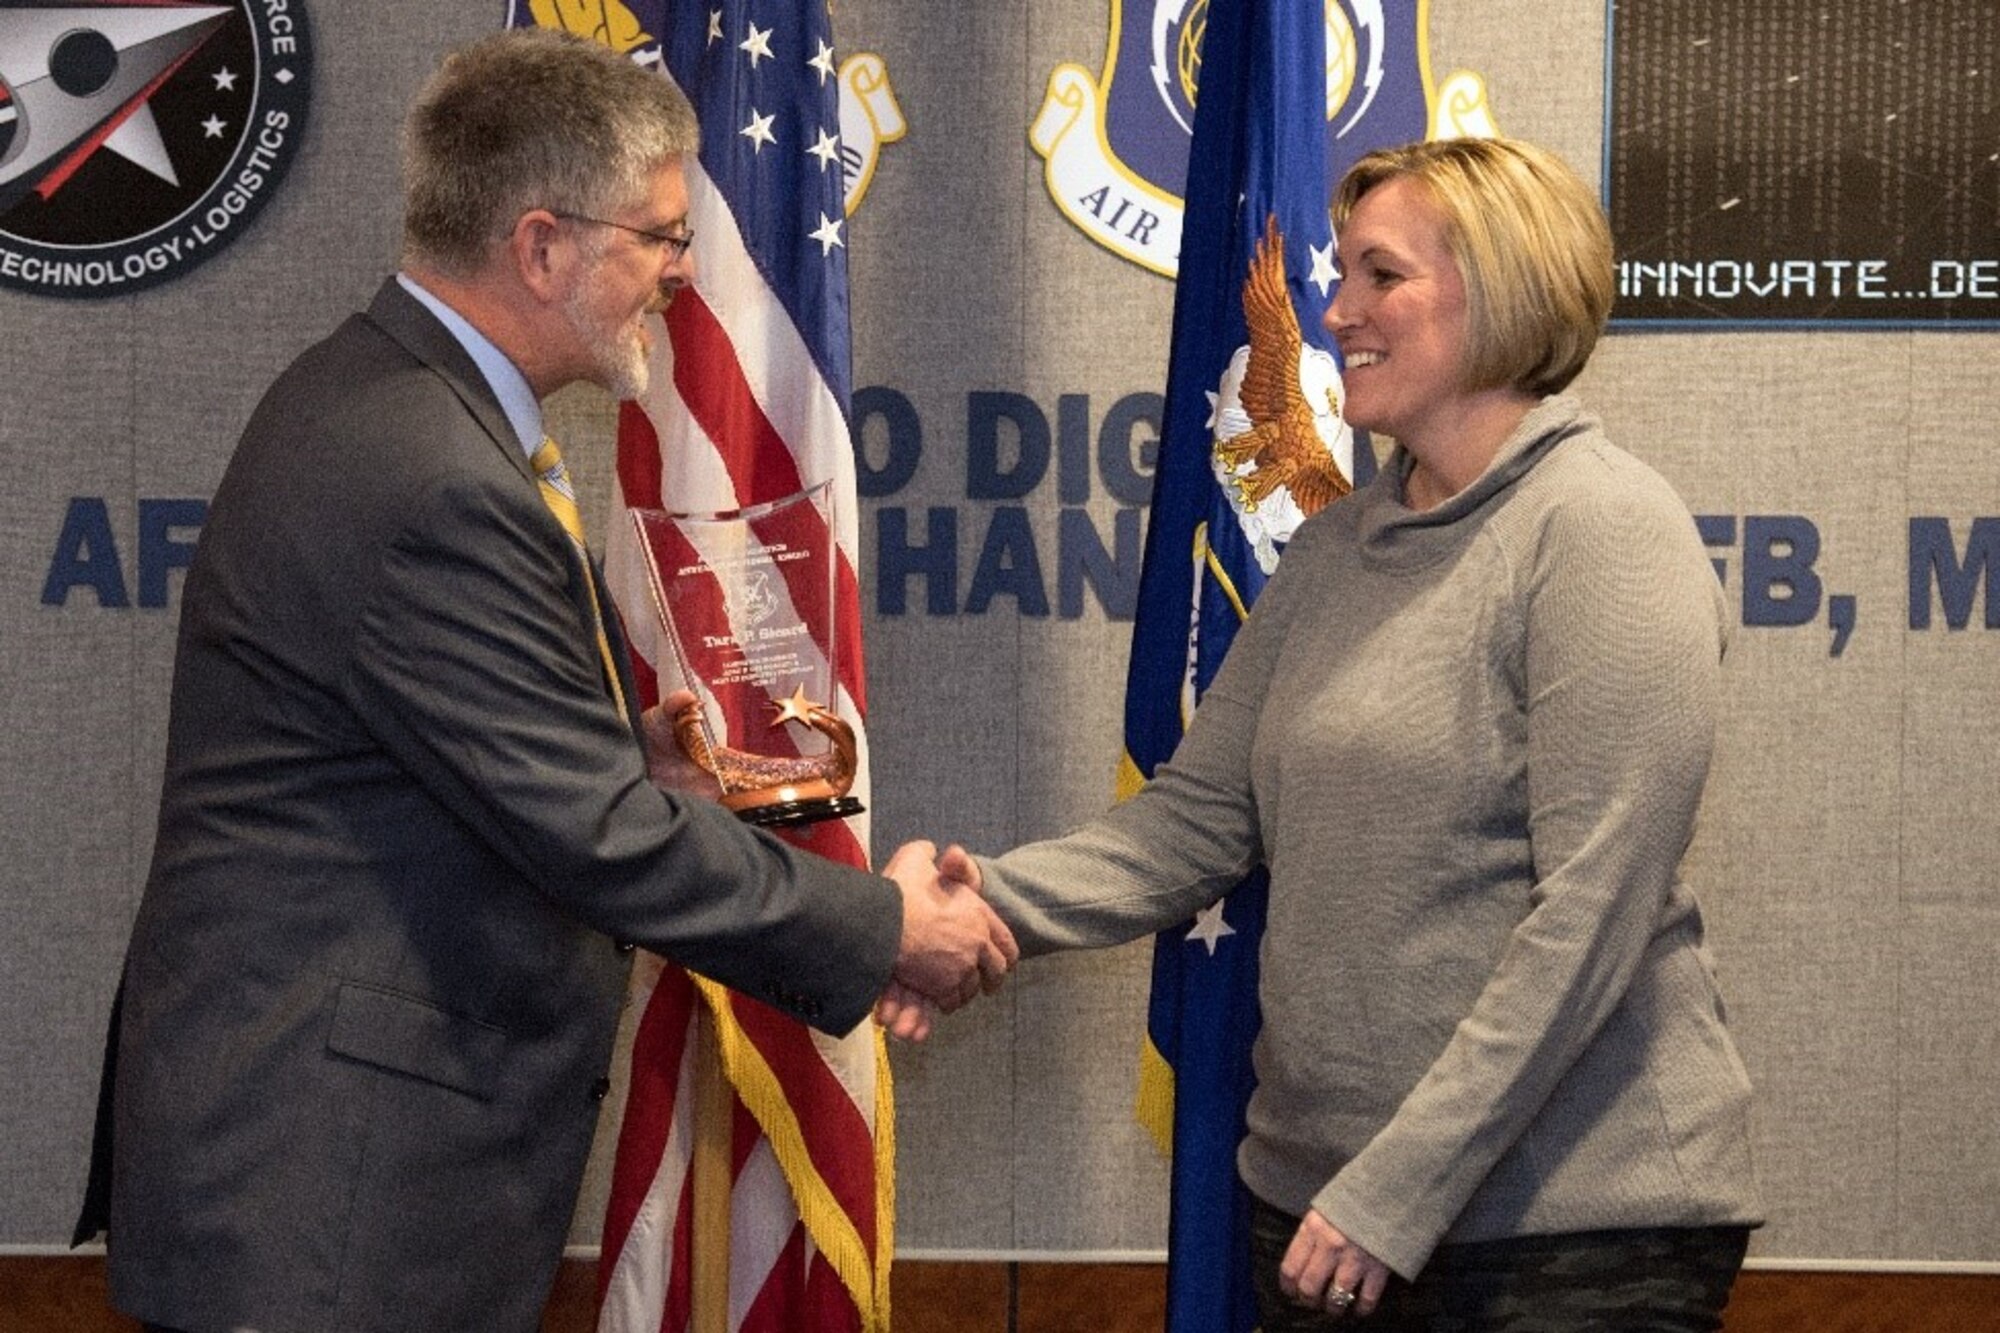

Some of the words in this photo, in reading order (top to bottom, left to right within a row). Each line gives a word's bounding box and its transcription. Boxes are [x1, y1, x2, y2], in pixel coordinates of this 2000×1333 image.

[0, 236, 184, 286] ECHNOLOGY
[191, 109, 290, 245] LOGISTICS
[1078, 185, 1160, 246] AIR
[40, 496, 209, 609] AF
[876, 506, 1143, 623] HAN
